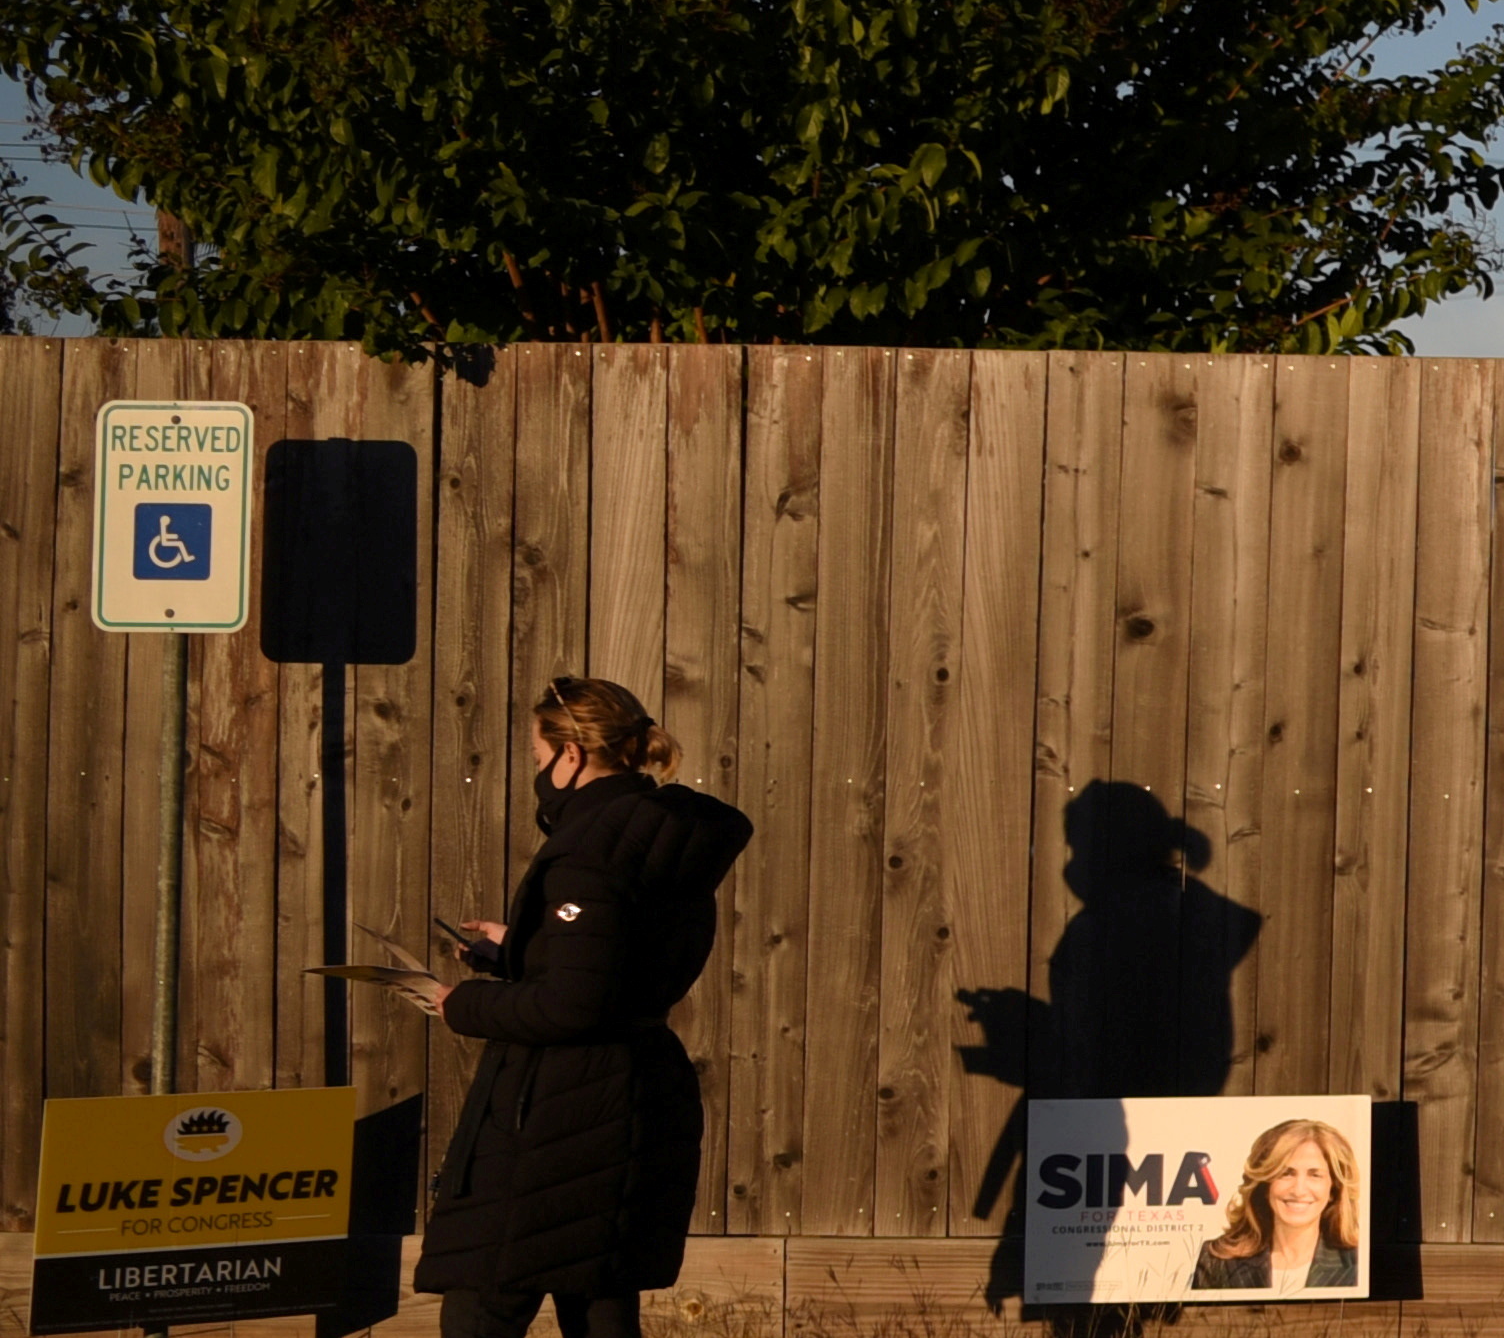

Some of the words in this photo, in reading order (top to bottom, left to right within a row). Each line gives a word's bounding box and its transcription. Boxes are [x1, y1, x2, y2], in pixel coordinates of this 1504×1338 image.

[111, 425, 241, 453] RESERVED
[118, 464, 231, 491] PARKING
[56, 1179, 163, 1213] LUKE
[170, 1169, 338, 1207] SPENCER
[1037, 1151, 1219, 1210] SIMA
[121, 1218, 162, 1237] FOR
[168, 1211, 273, 1234] CONGRESS
[1052, 1225, 1142, 1235] CONGRESSIONAL
[1146, 1223, 1195, 1234] DISTRICT
[1198, 1223, 1205, 1233] 2
[1080, 1210, 1117, 1222] FOR
[1127, 1209, 1186, 1221] TEXAS
[99, 1257, 282, 1290] LIBERTARIAN
[109, 1291, 141, 1302] PEACE
[154, 1287, 212, 1299] PROSPERITY
[224, 1282, 271, 1294] FREEDOM
